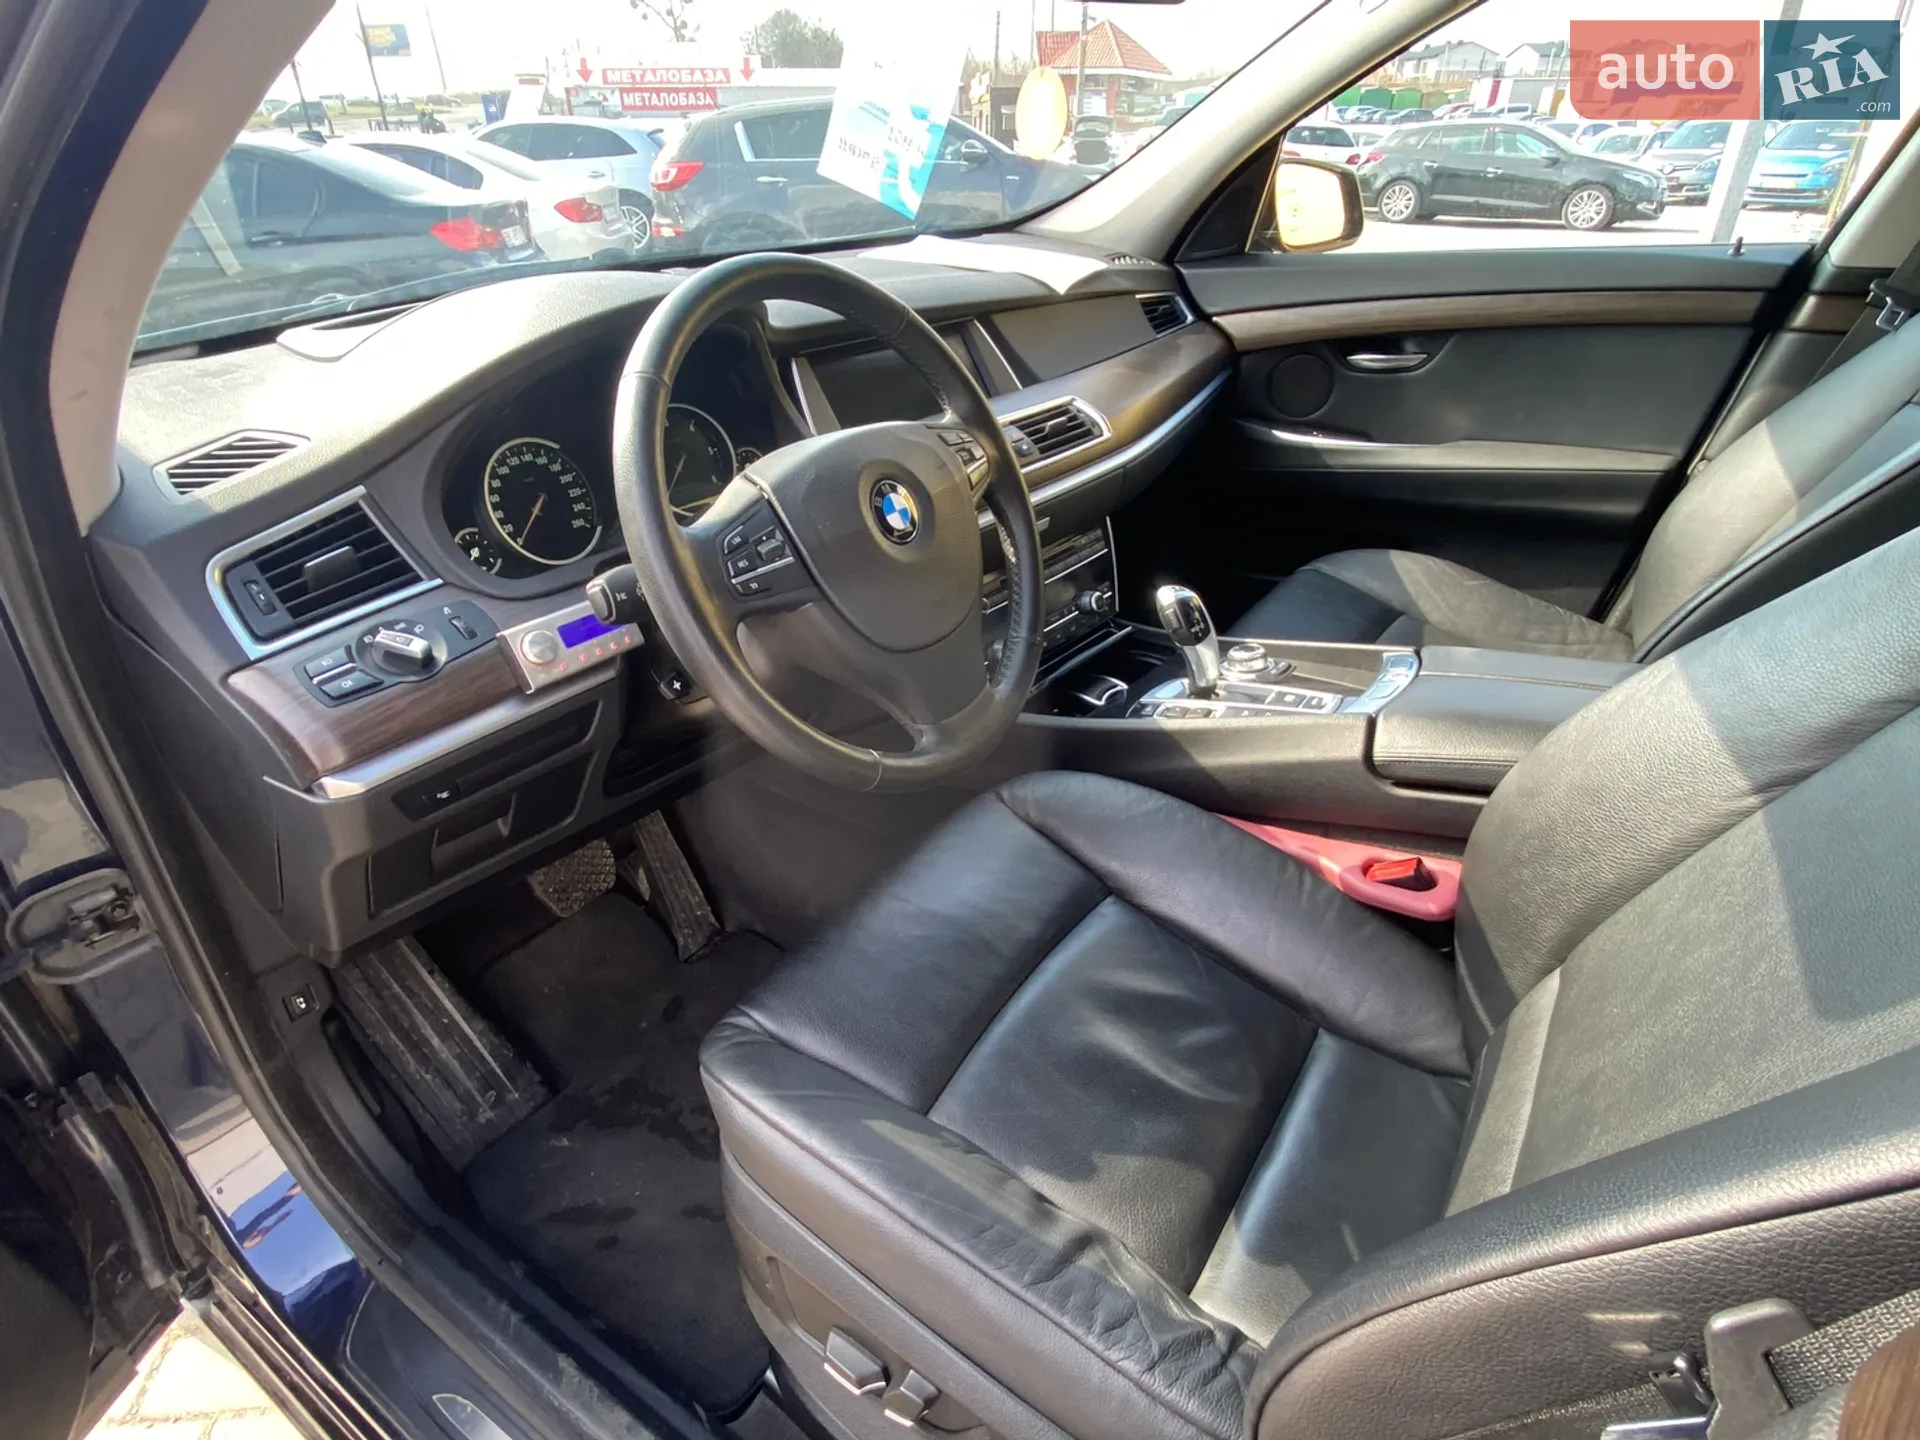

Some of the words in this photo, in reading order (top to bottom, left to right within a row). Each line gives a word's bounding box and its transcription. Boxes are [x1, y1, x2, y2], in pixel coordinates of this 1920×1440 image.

[606, 69, 728, 84] МЕТАЛОБАЗА
[622, 92, 715, 107] МЕТАЛОБАЗА
[506, 456, 520, 466] 120
[519, 453, 534, 463] 140
[496, 465, 510, 475] 100
[559, 473, 573, 484] 200
[568, 487, 582, 498] 220
[572, 502, 586, 512] 240
[503, 523, 514, 533] 20
